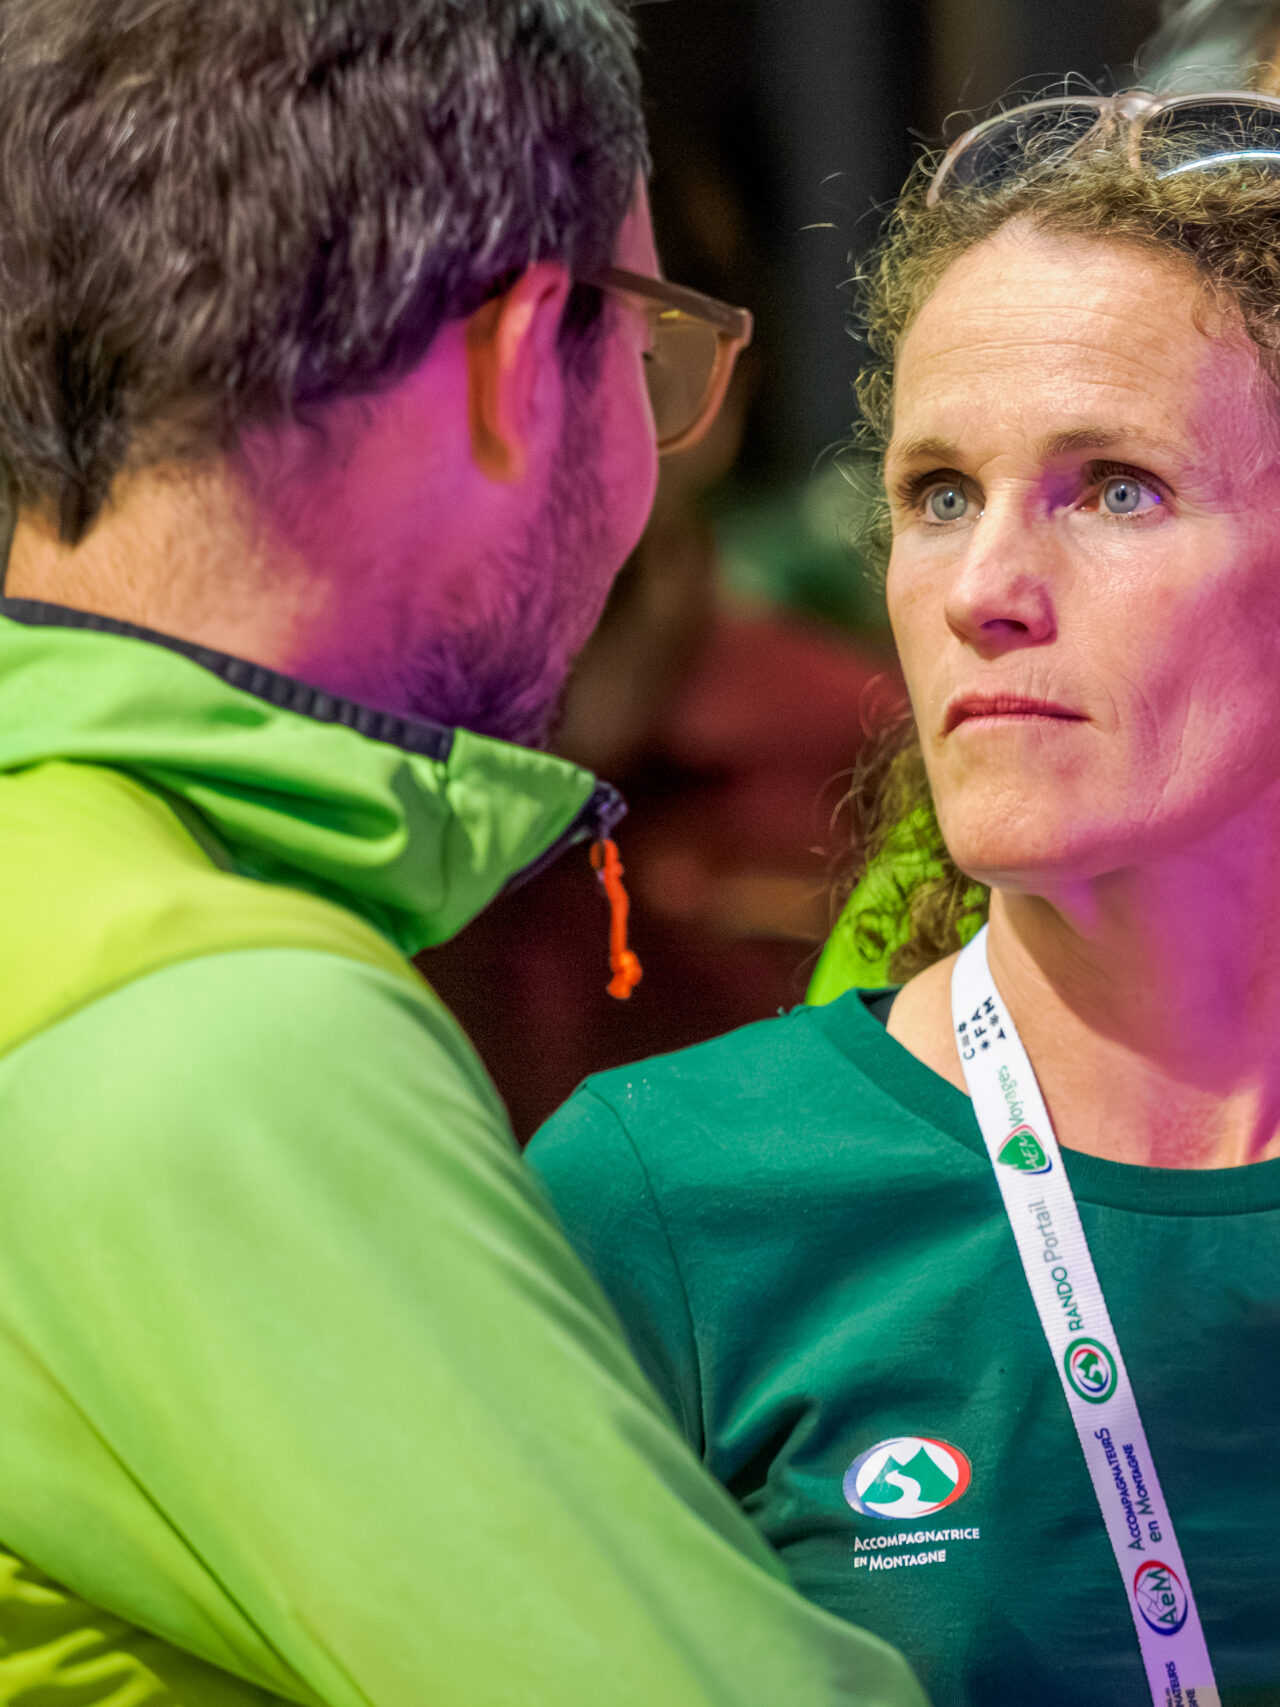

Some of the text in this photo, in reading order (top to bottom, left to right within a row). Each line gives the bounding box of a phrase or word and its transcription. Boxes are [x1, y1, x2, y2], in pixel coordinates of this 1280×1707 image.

[997, 1064, 1025, 1128] Voyages
[1027, 1196, 1084, 1331] RANDO Portail
[854, 1528, 980, 1552] ACCOMPAGNATRICE
[1148, 1520, 1162, 1543] en
[868, 1549, 946, 1571] MONTAGNE
